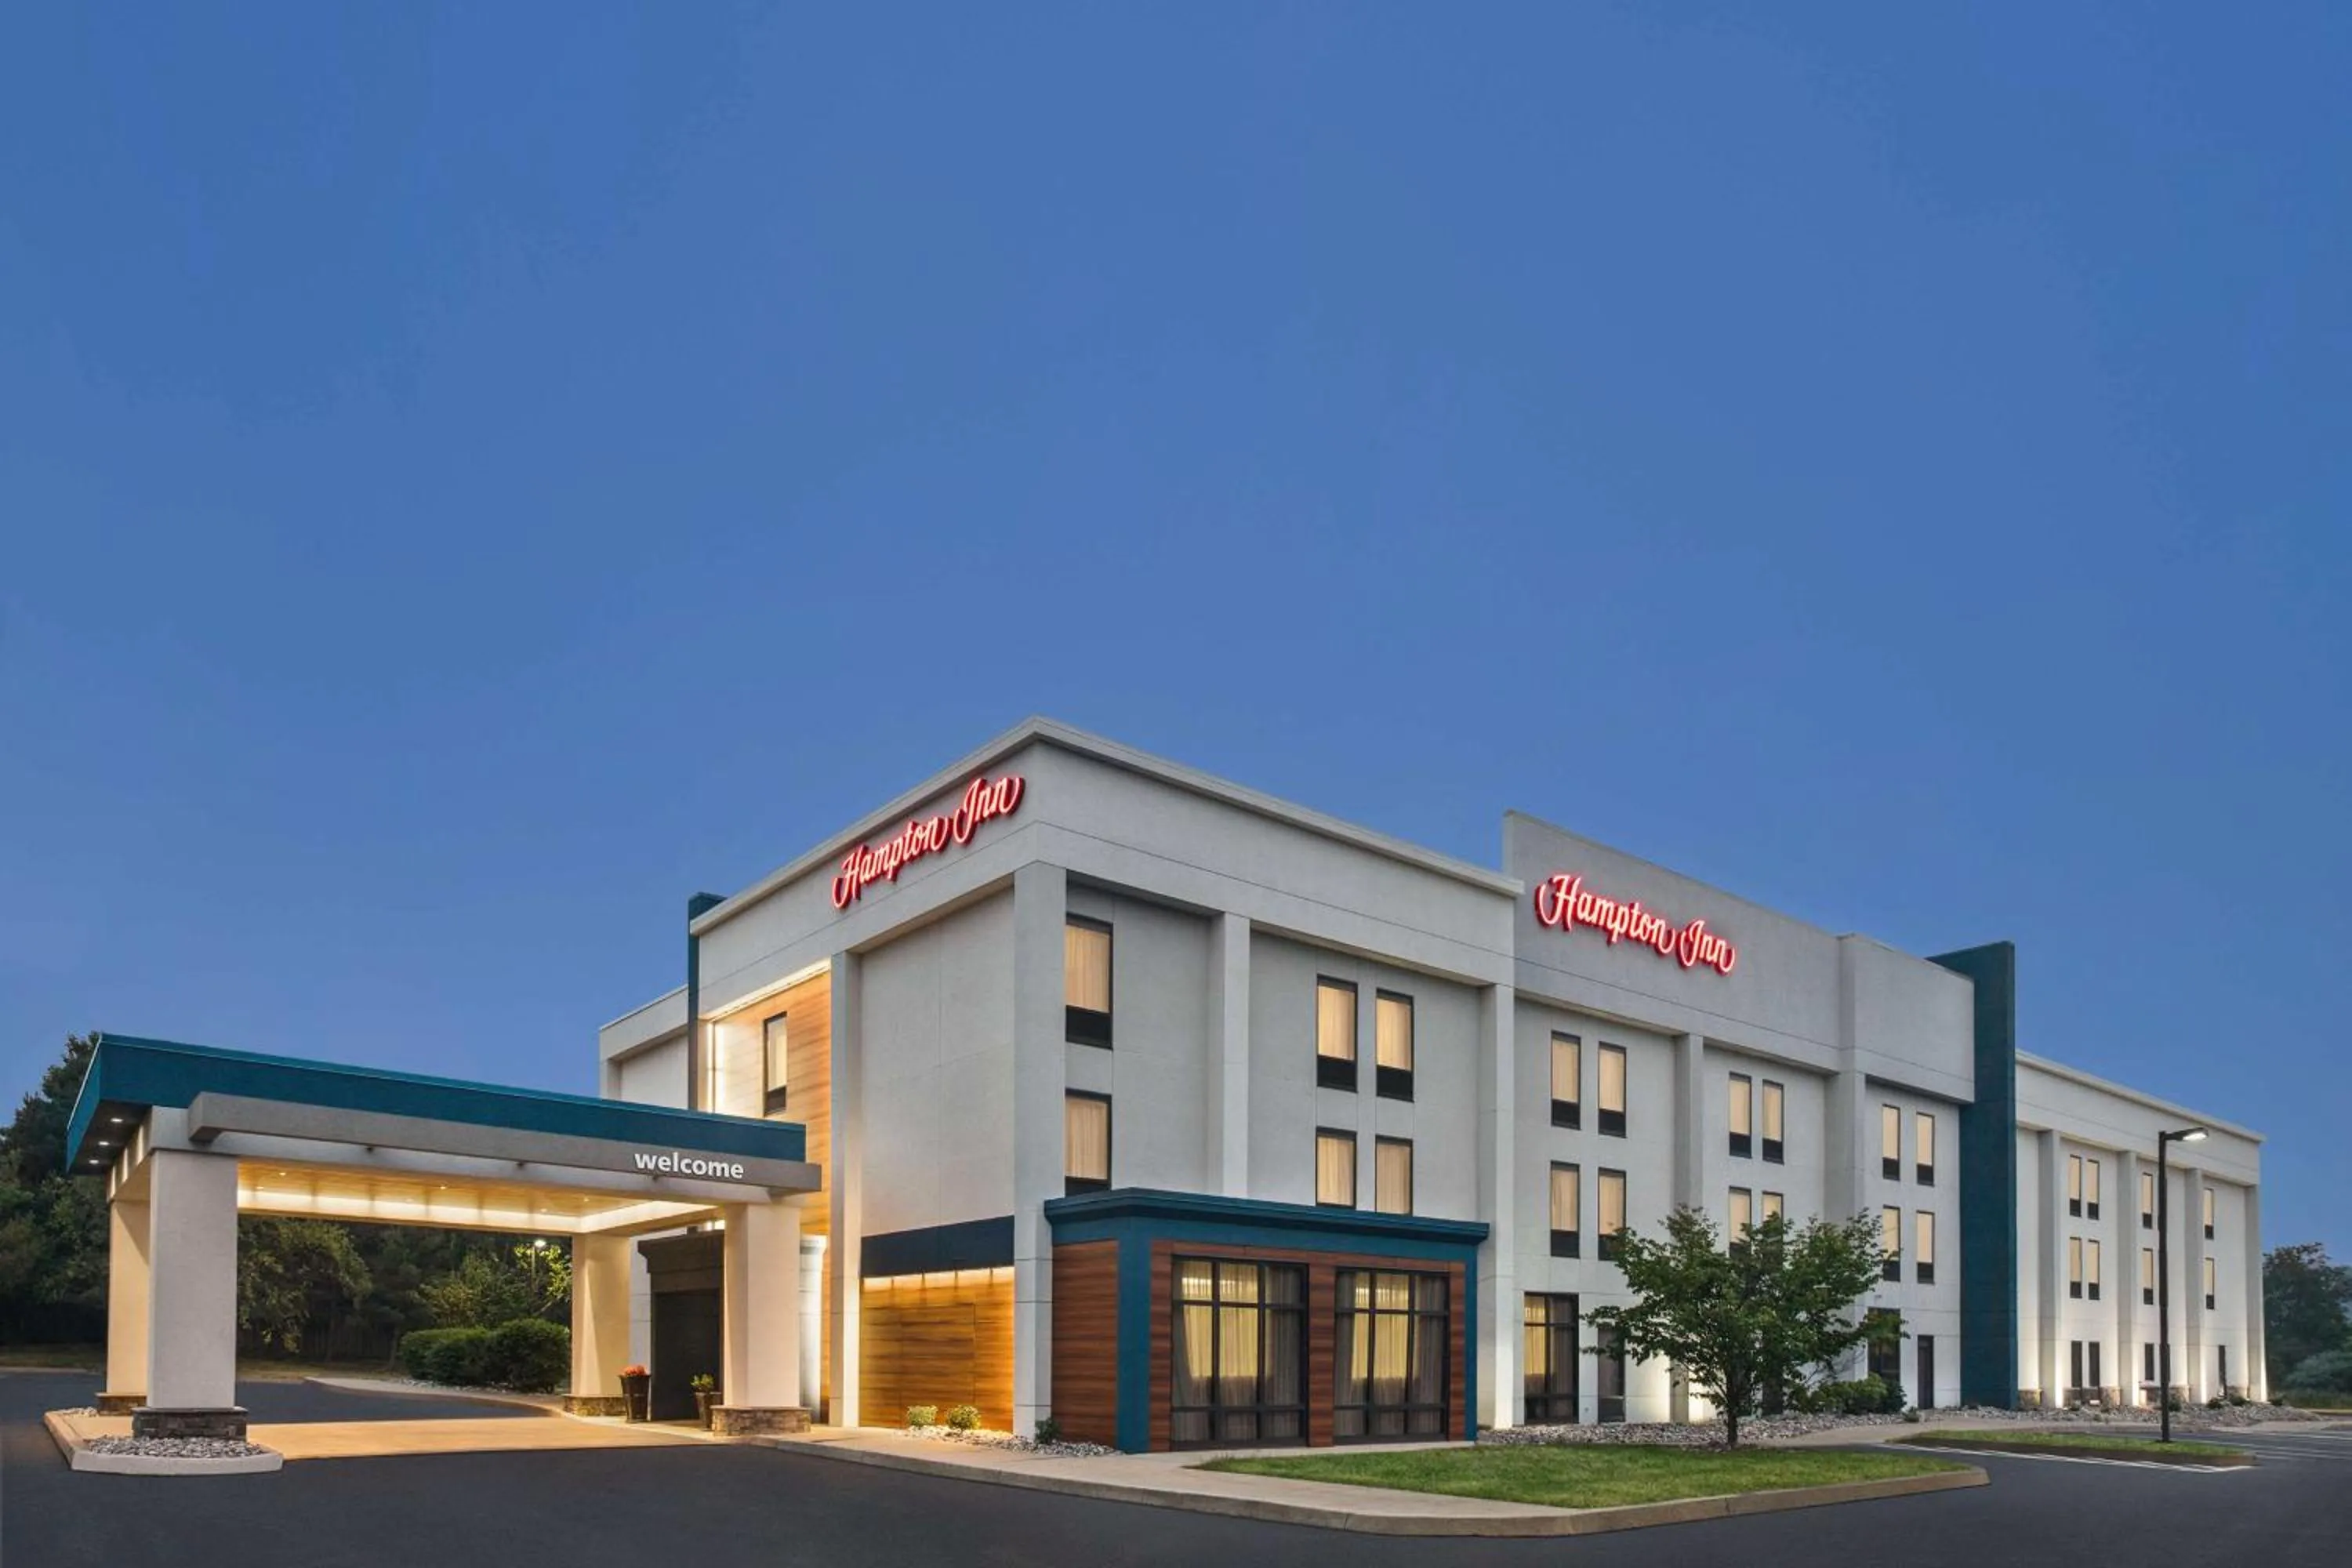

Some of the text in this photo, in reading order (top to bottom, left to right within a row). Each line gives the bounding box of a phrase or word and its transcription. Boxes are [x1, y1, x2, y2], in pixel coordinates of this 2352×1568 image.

[832, 777, 1025, 908] Hampton Inn
[1535, 874, 1735, 974] Hampton Inn
[634, 1152, 744, 1178] welcome
